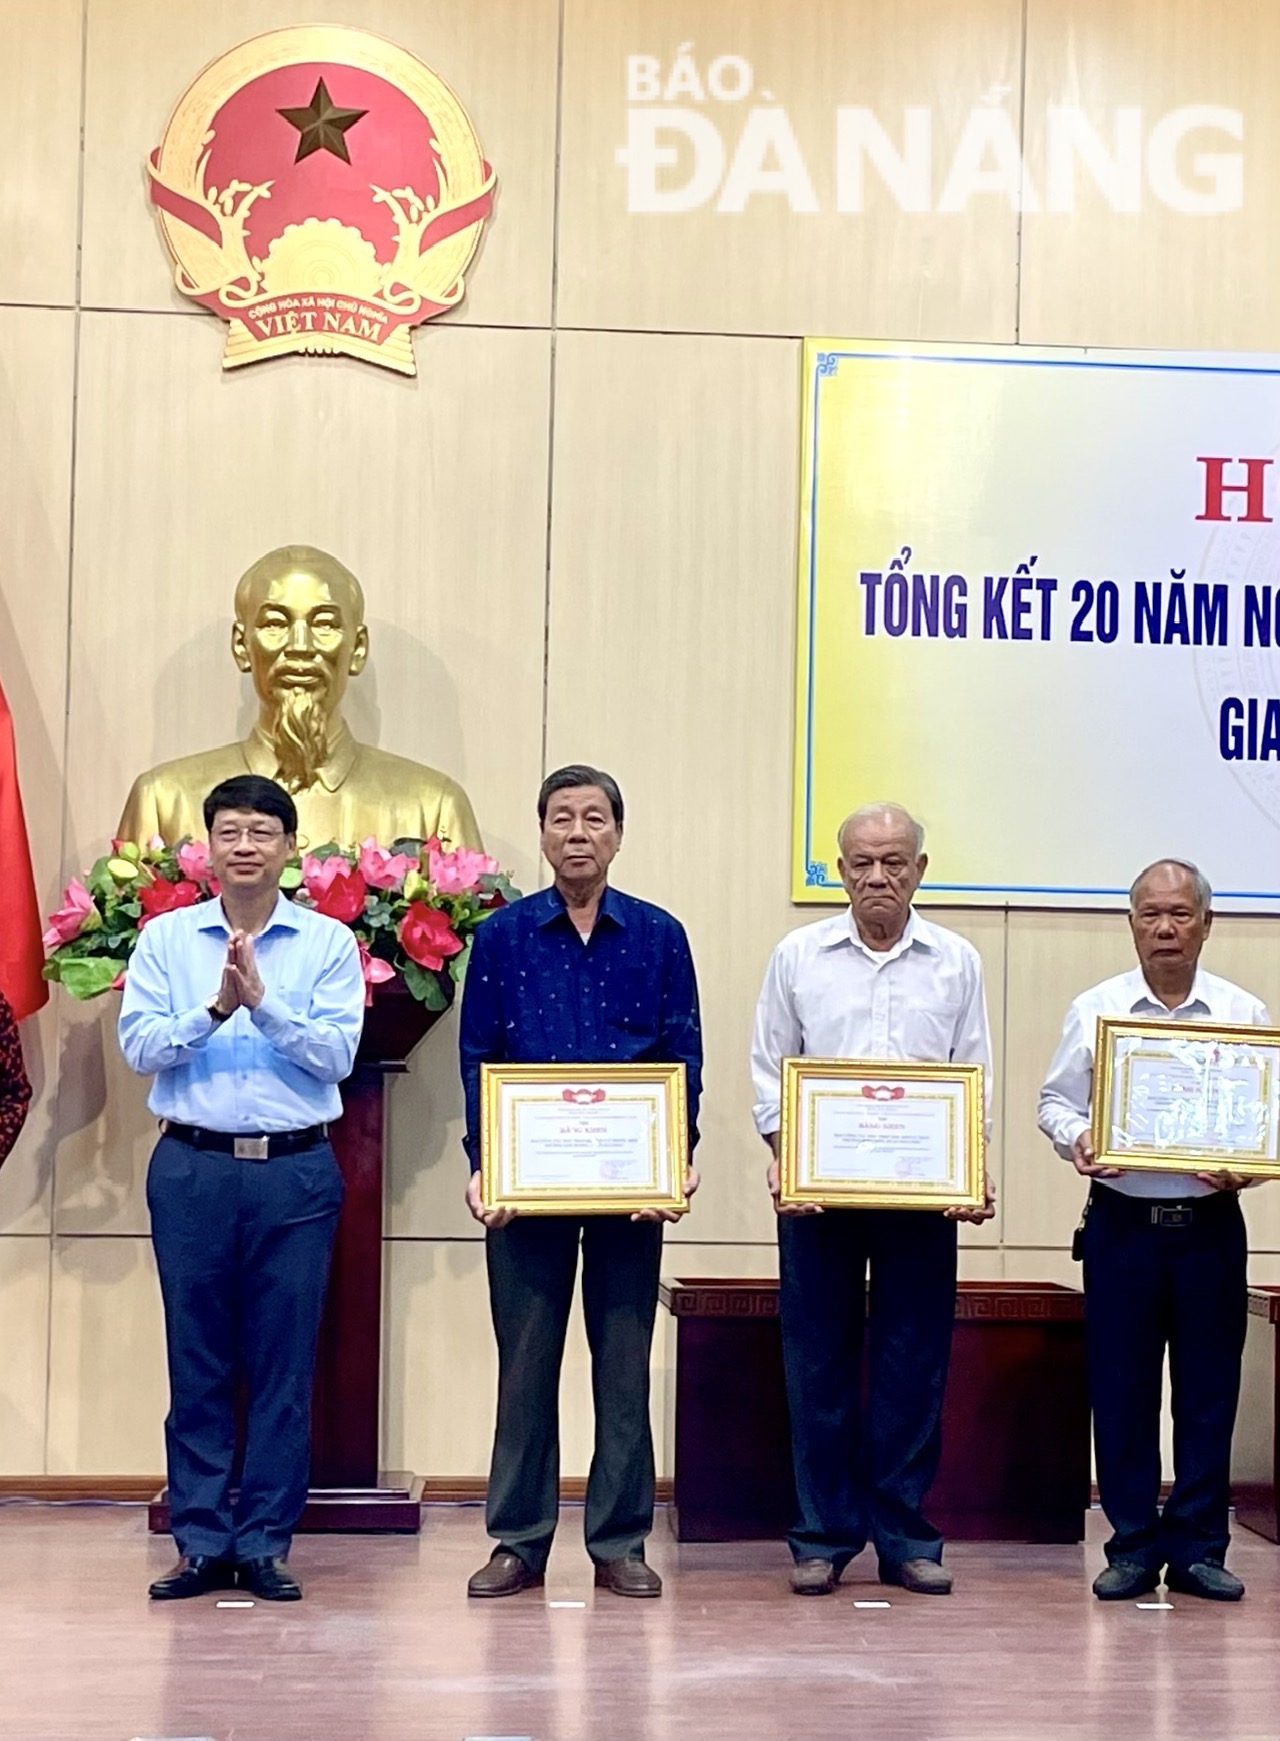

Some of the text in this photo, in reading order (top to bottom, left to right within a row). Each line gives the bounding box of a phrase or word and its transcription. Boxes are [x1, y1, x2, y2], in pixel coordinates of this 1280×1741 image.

[255, 311, 382, 340] VIỆT NAM
[860, 546, 968, 639] TỔNG
[982, 555, 1058, 641] KẾT
[1069, 580, 1120, 644] 20
[1133, 568, 1229, 647] NĂM
